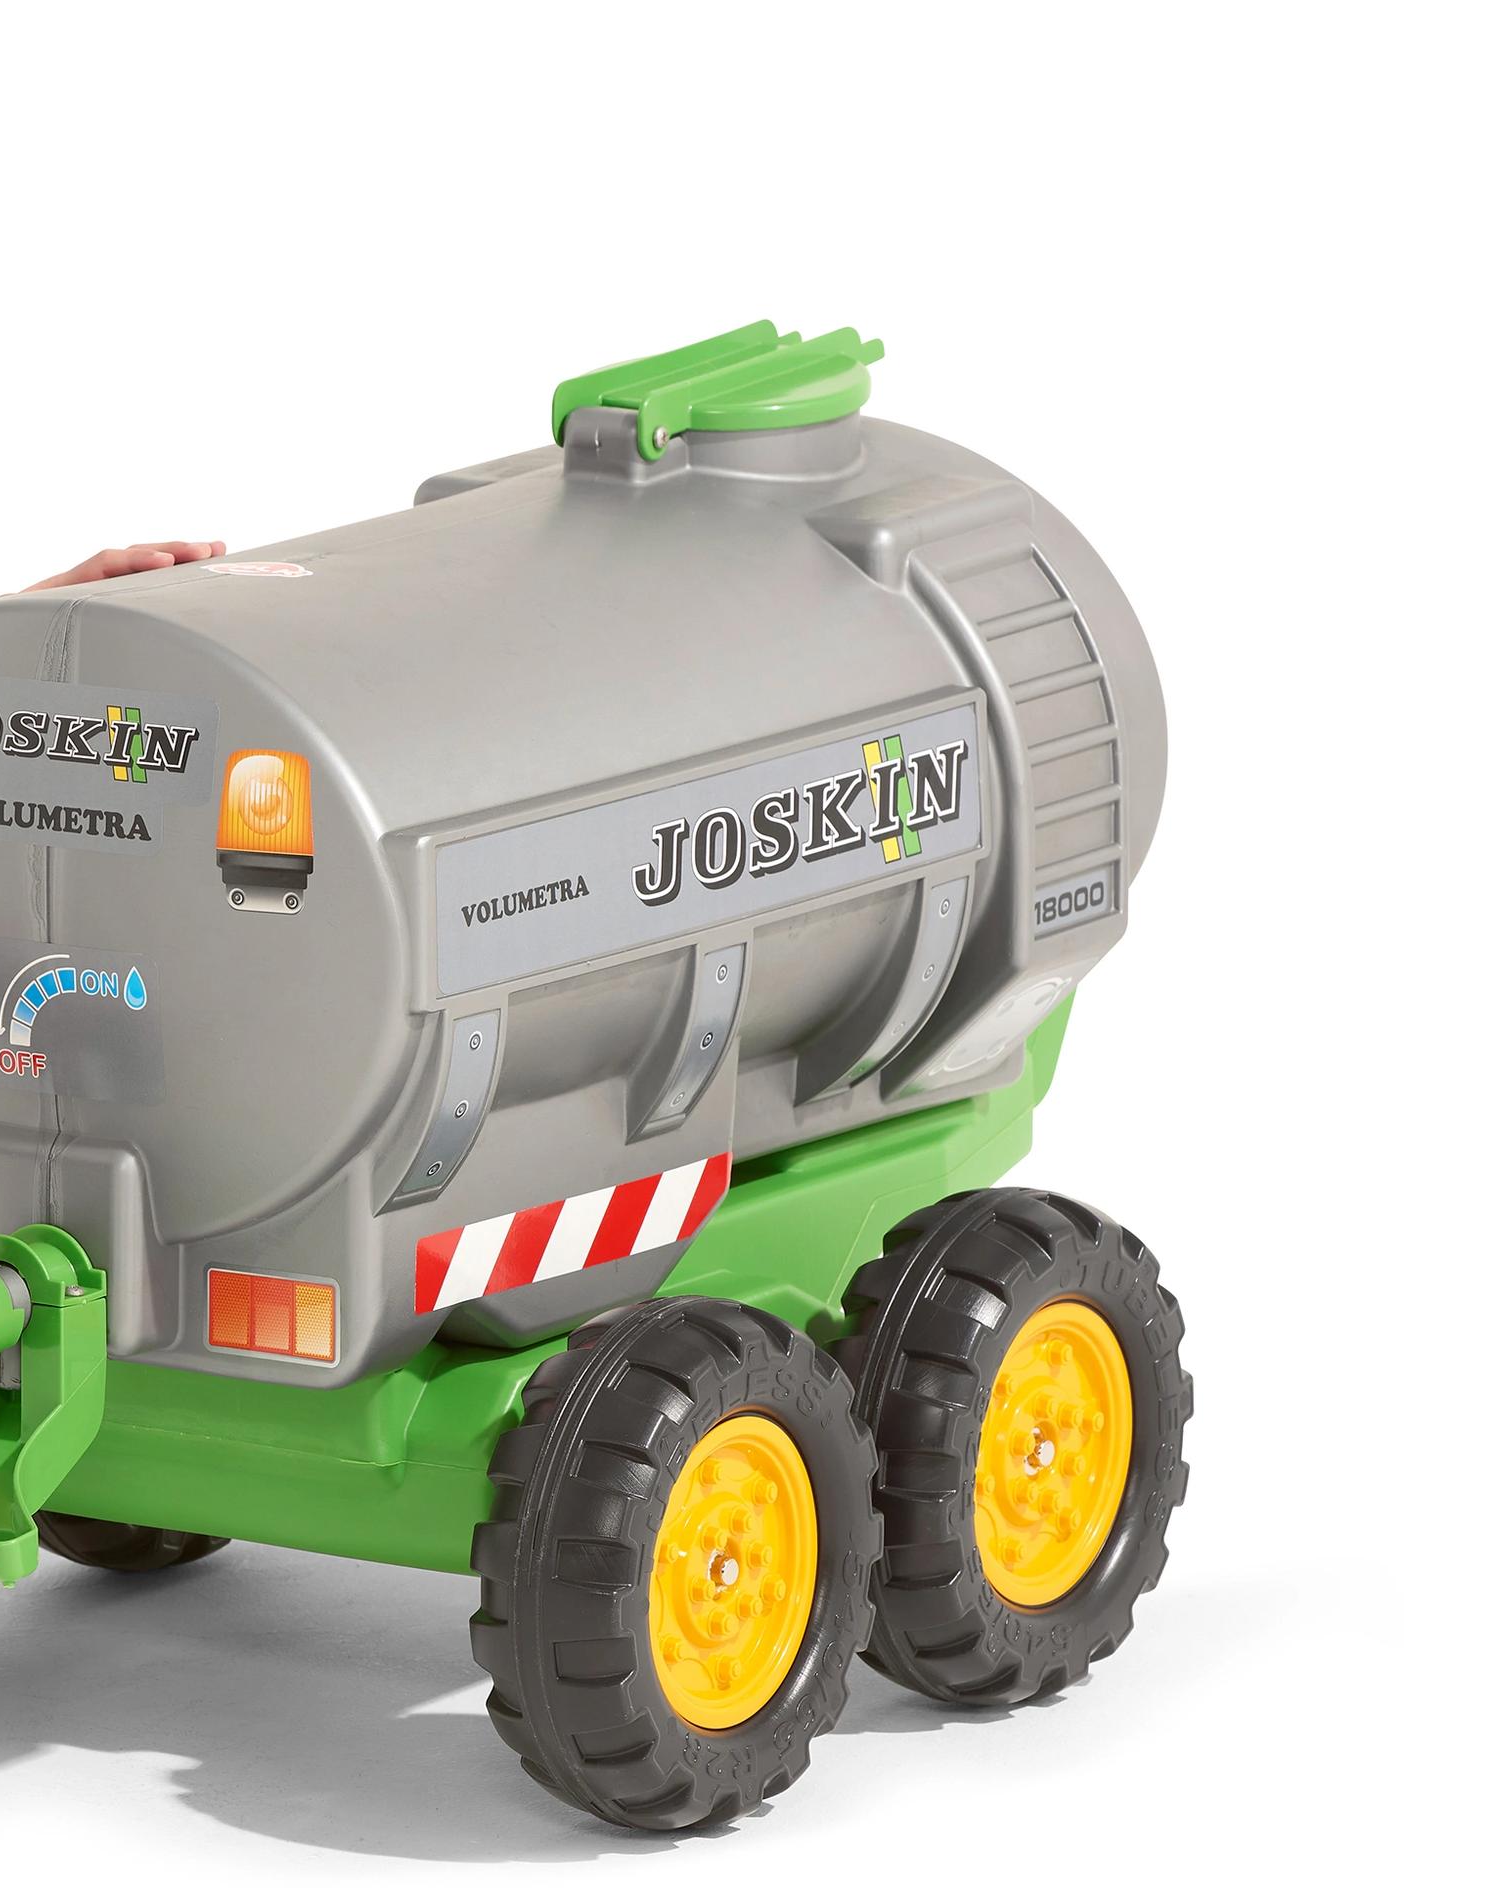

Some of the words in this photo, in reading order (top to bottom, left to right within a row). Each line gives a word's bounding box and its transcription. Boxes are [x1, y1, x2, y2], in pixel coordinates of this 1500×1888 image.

[632, 739, 969, 907] JOSKIN
[461, 875, 590, 928] VOLUMETRA
[1034, 881, 1104, 925] 18000
[80, 969, 119, 999] ON
